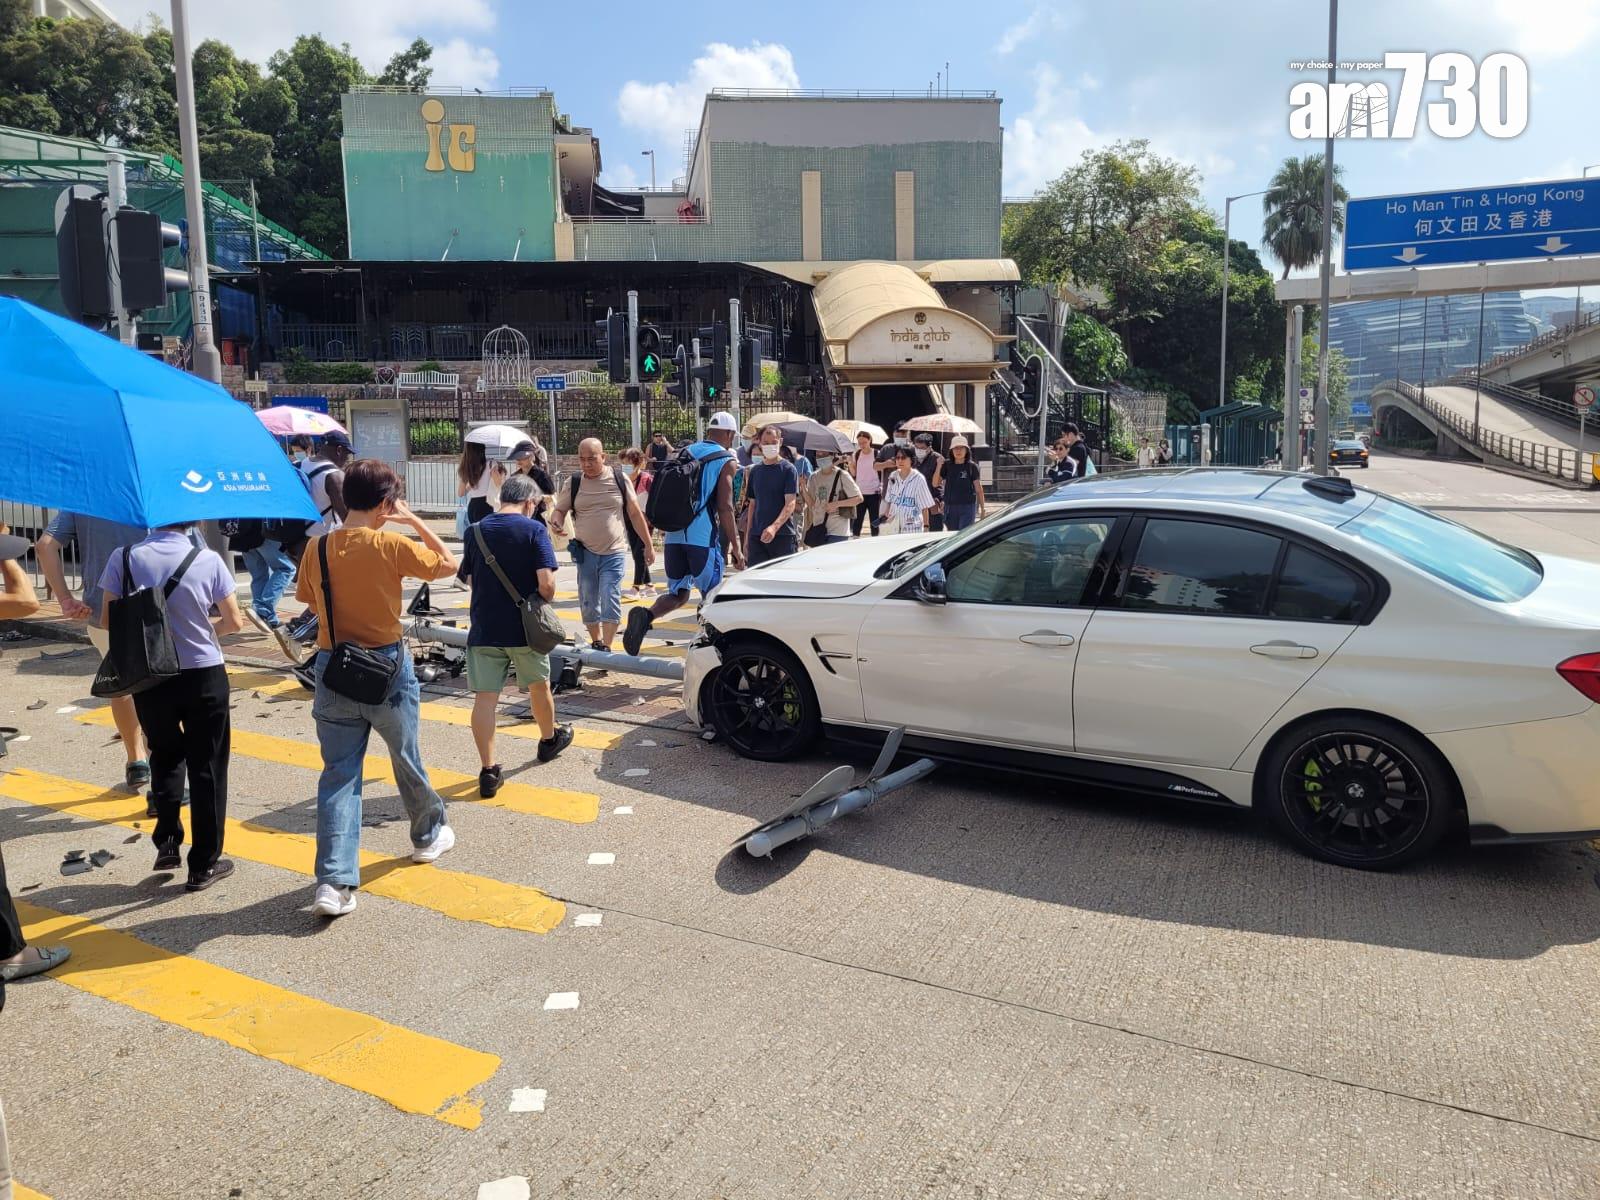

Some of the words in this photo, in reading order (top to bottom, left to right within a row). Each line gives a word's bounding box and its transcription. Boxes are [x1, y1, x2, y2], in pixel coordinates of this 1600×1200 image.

[1386, 202, 1407, 215] Ho
[1412, 199, 1444, 213] Man
[1450, 195, 1474, 209] Tin
[1479, 193, 1491, 207] &
[1496, 189, 1537, 206] Hong
[1543, 187, 1585, 203] Kong
[1414, 208, 1553, 237] 何文田及香港
[890, 327, 920, 343] india
[922, 326, 952, 342] club
